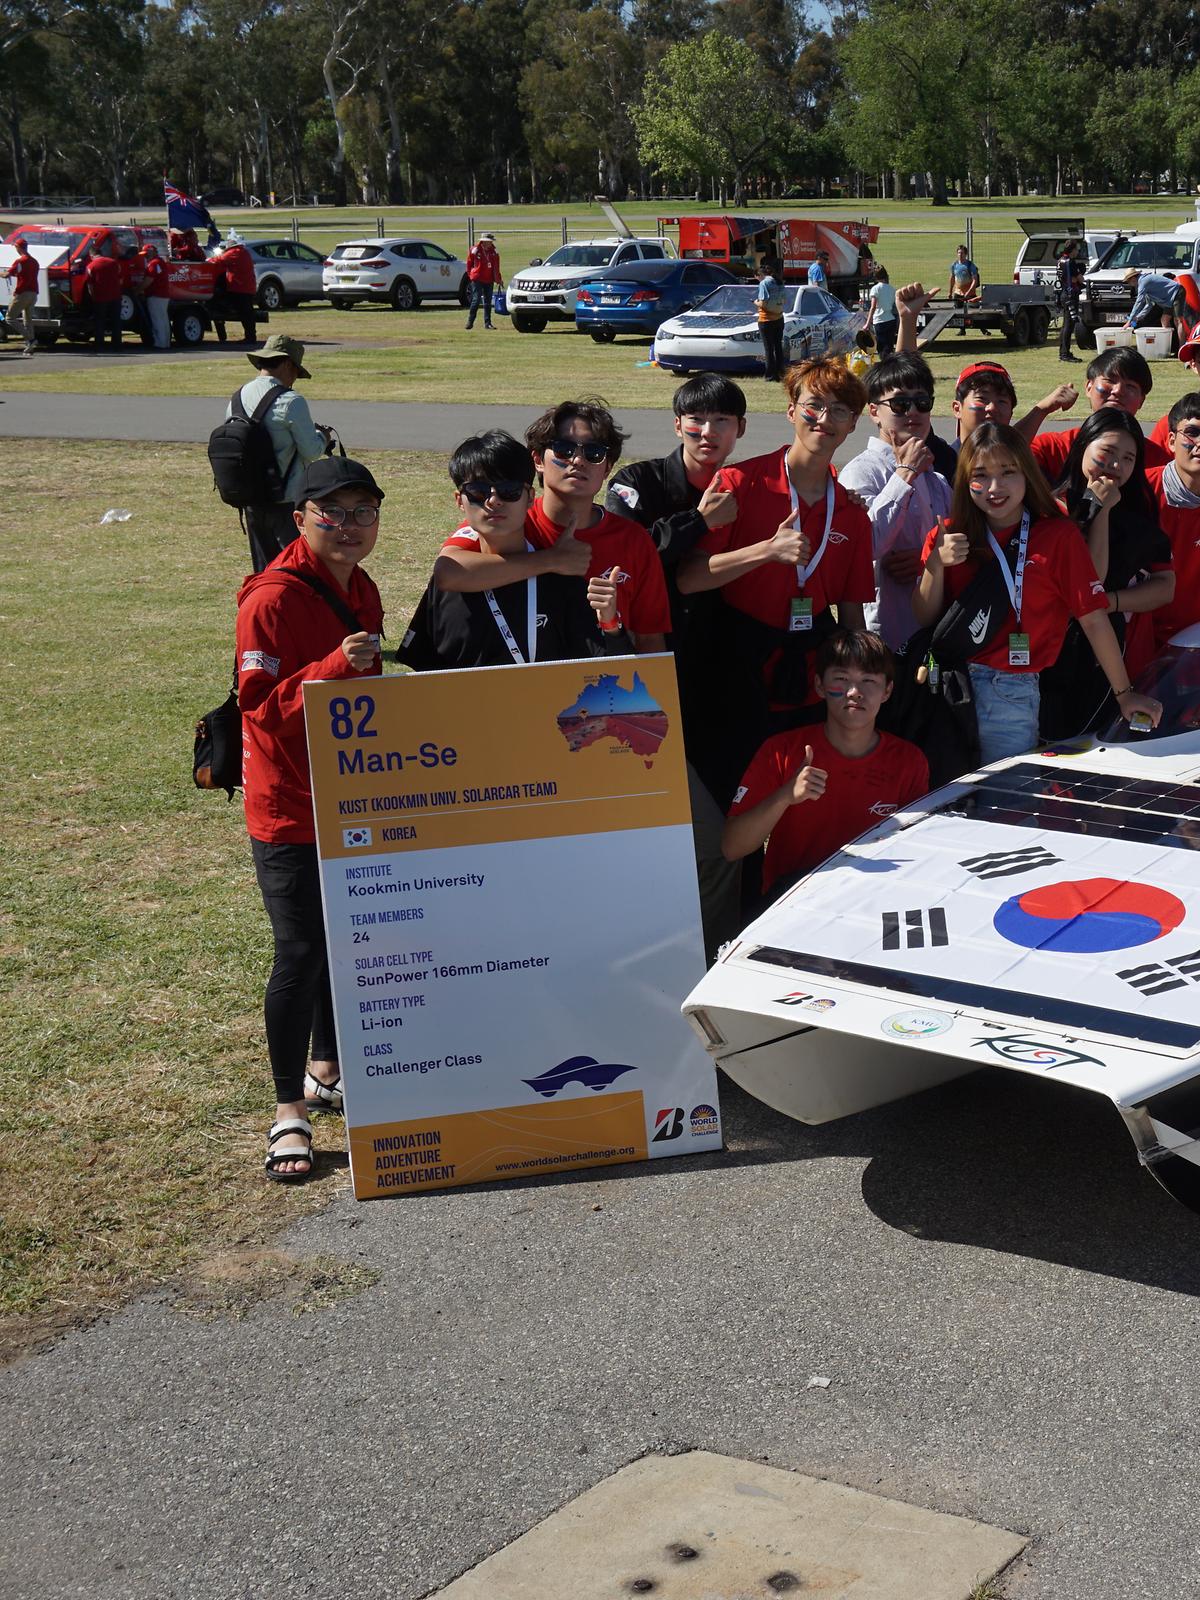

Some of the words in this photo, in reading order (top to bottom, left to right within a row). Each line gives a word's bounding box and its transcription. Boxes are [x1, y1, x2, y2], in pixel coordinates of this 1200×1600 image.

[968, 609, 987, 636] NIKE
[329, 695, 378, 740] 82
[337, 742, 457, 776] Man-Se
[339, 799, 368, 815] KUST
[371, 794, 428, 812] (KOOKMIN
[430, 791, 461, 807] UNIV.
[463, 786, 520, 803] SOLARCAR
[522, 781, 558, 798] TEAM)
[382, 826, 417, 842] KOREA
[345, 864, 393, 880] INSTITUTE
[348, 880, 411, 897] Kookmin
[414, 873, 485, 891] University
[350, 913, 377, 926] TEAM
[378, 907, 424, 923] MEMBERS
[352, 932, 370, 944] 24
[355, 956, 385, 970] SOLAR
[386, 953, 409, 967] CELL
[410, 950, 434, 964] TYPE
[356, 970, 429, 987] SunPower
[432, 963, 483, 979] 166mm
[486, 956, 550, 973] Diameter
[359, 998, 400, 1013] BATTERY
[402, 994, 426, 1008] TYPE
[361, 1016, 403, 1031] Li-ion
[363, 1043, 393, 1057] CLASS
[970, 1033, 1108, 1071] KUST
[365, 1058, 442, 1077] Challenger
[444, 1053, 483, 1068] Class
[690, 1117, 718, 1126] WORLD
[691, 1124, 718, 1133] SOLAR
[373, 1131, 442, 1153] INNOVATION
[375, 1148, 442, 1171] ADVENTURE
[495, 1146, 635, 1172] www.worldsolarchallenge.org
[377, 1164, 456, 1188] ACHIEVEMENT
